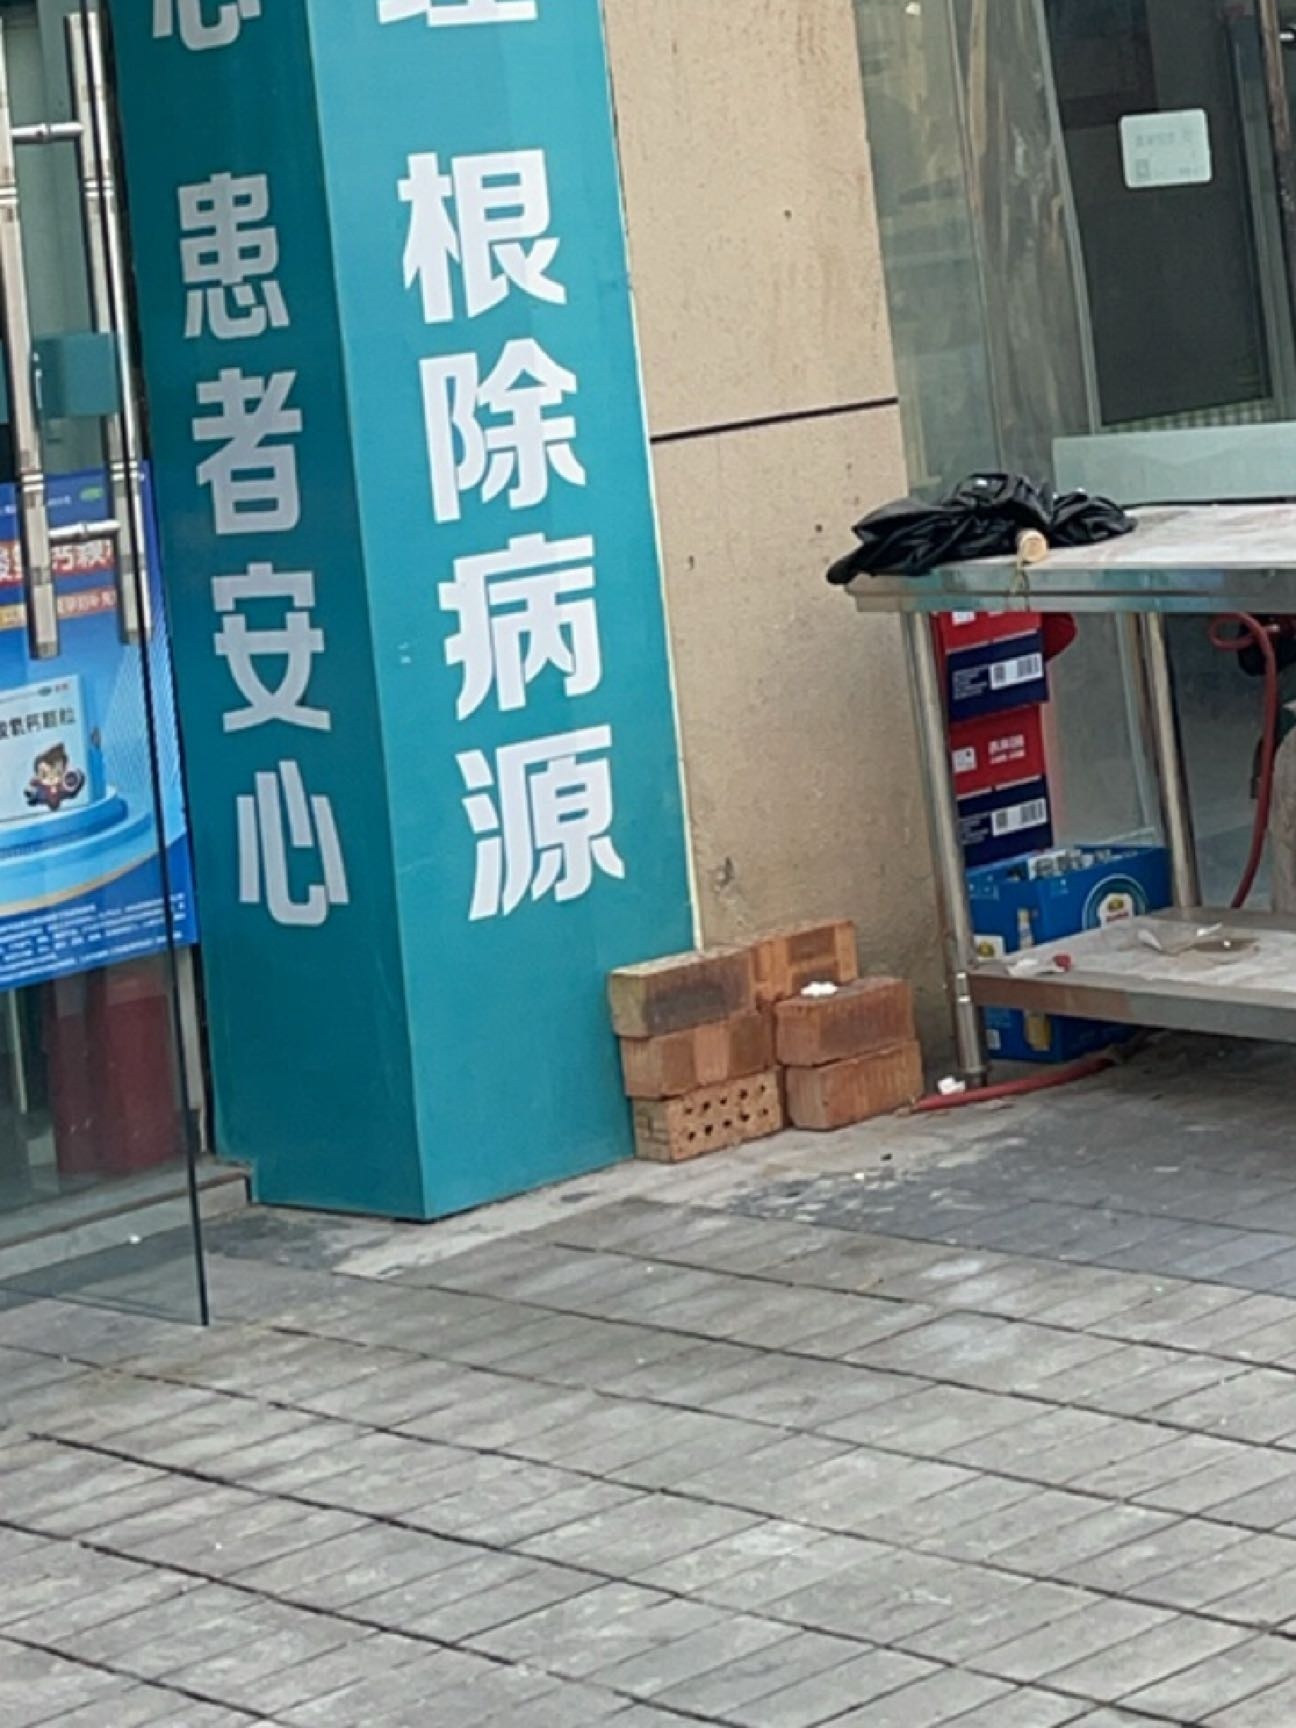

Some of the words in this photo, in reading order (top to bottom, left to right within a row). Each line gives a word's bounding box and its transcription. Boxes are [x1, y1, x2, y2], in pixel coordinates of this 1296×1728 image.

[175, 170, 351, 929] 患者安心
[397, 147, 626, 922] 根除病源
